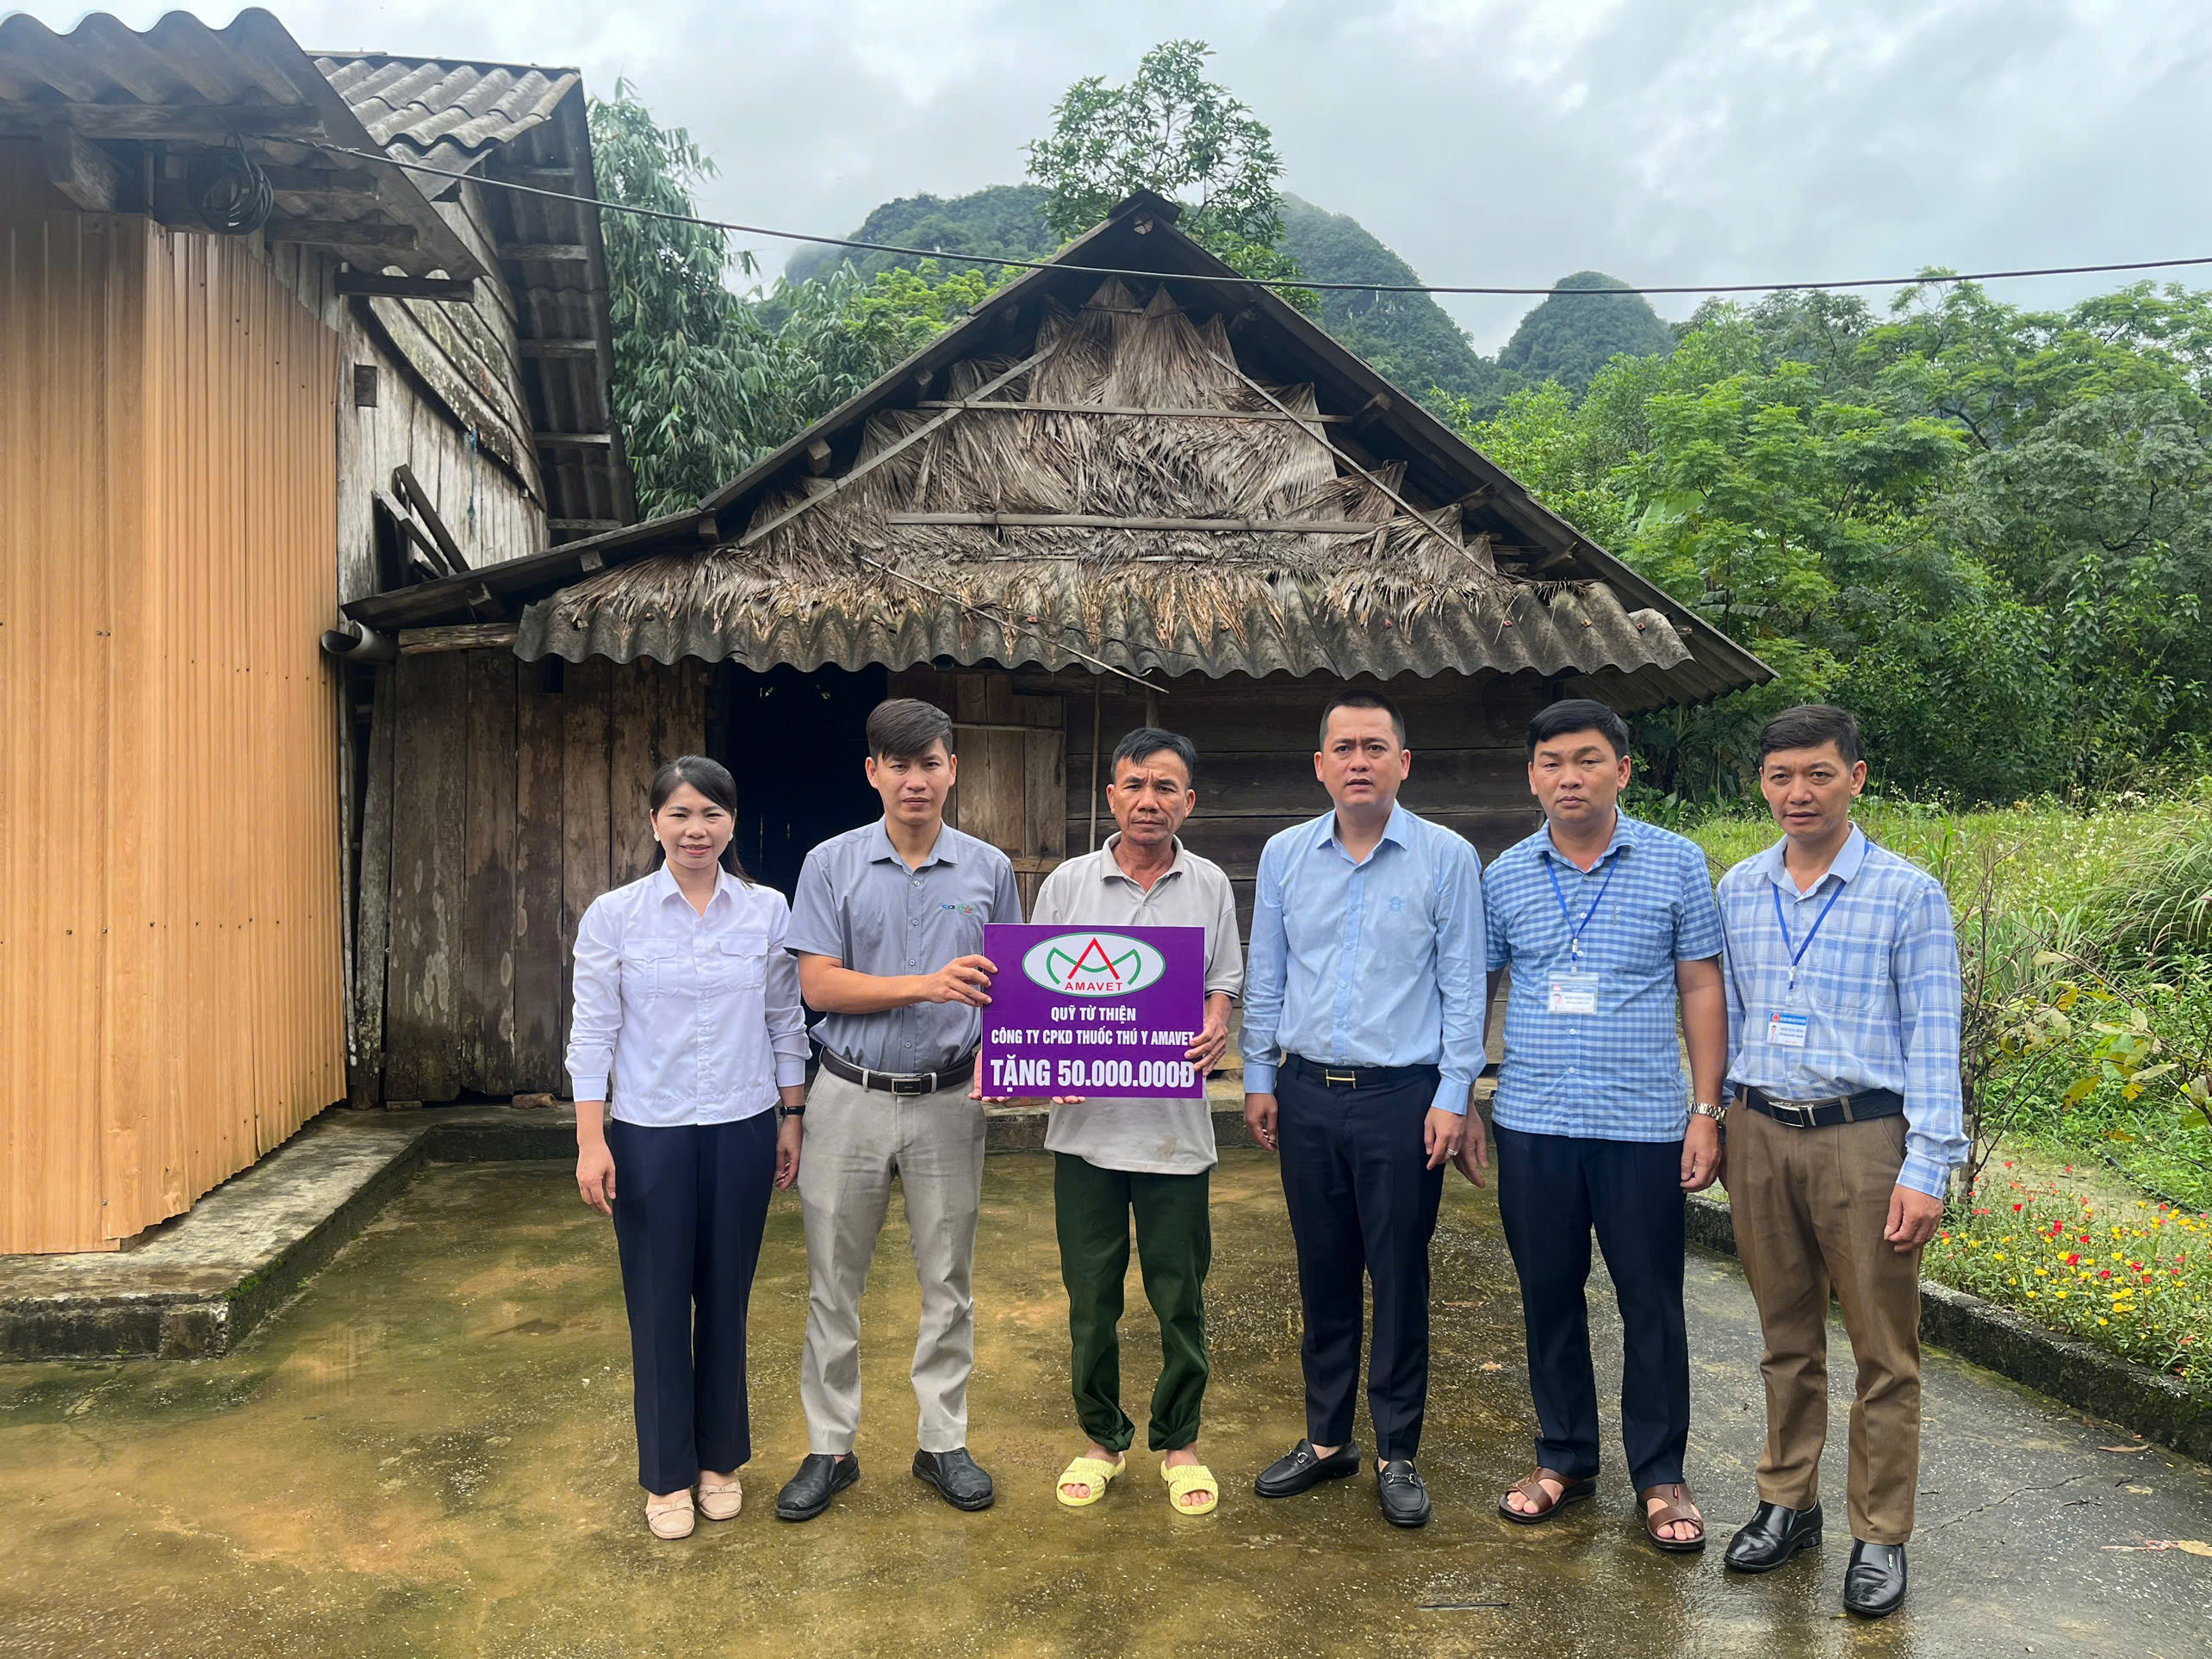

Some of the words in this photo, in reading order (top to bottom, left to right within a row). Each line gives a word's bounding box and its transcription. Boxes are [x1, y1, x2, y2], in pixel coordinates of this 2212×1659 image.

[1065, 982, 1122, 991] AMAVET
[1051, 1004, 1076, 1022] QUỸ
[1079, 1004, 1097, 1021] TỪ
[1098, 1004, 1136, 1024] THIỆN
[991, 1027, 1022, 1044] CÔNG
[1026, 1029, 1040, 1044] TY
[1042, 1029, 1073, 1044] CPKD
[1076, 1025, 1113, 1045] THUỐC
[1116, 1028, 1138, 1045] THÚ
[1140, 1030, 1148, 1045] Y
[990, 1053, 1051, 1092] TẶNG
[1058, 1059, 1195, 1088] 50.000.000Đ
